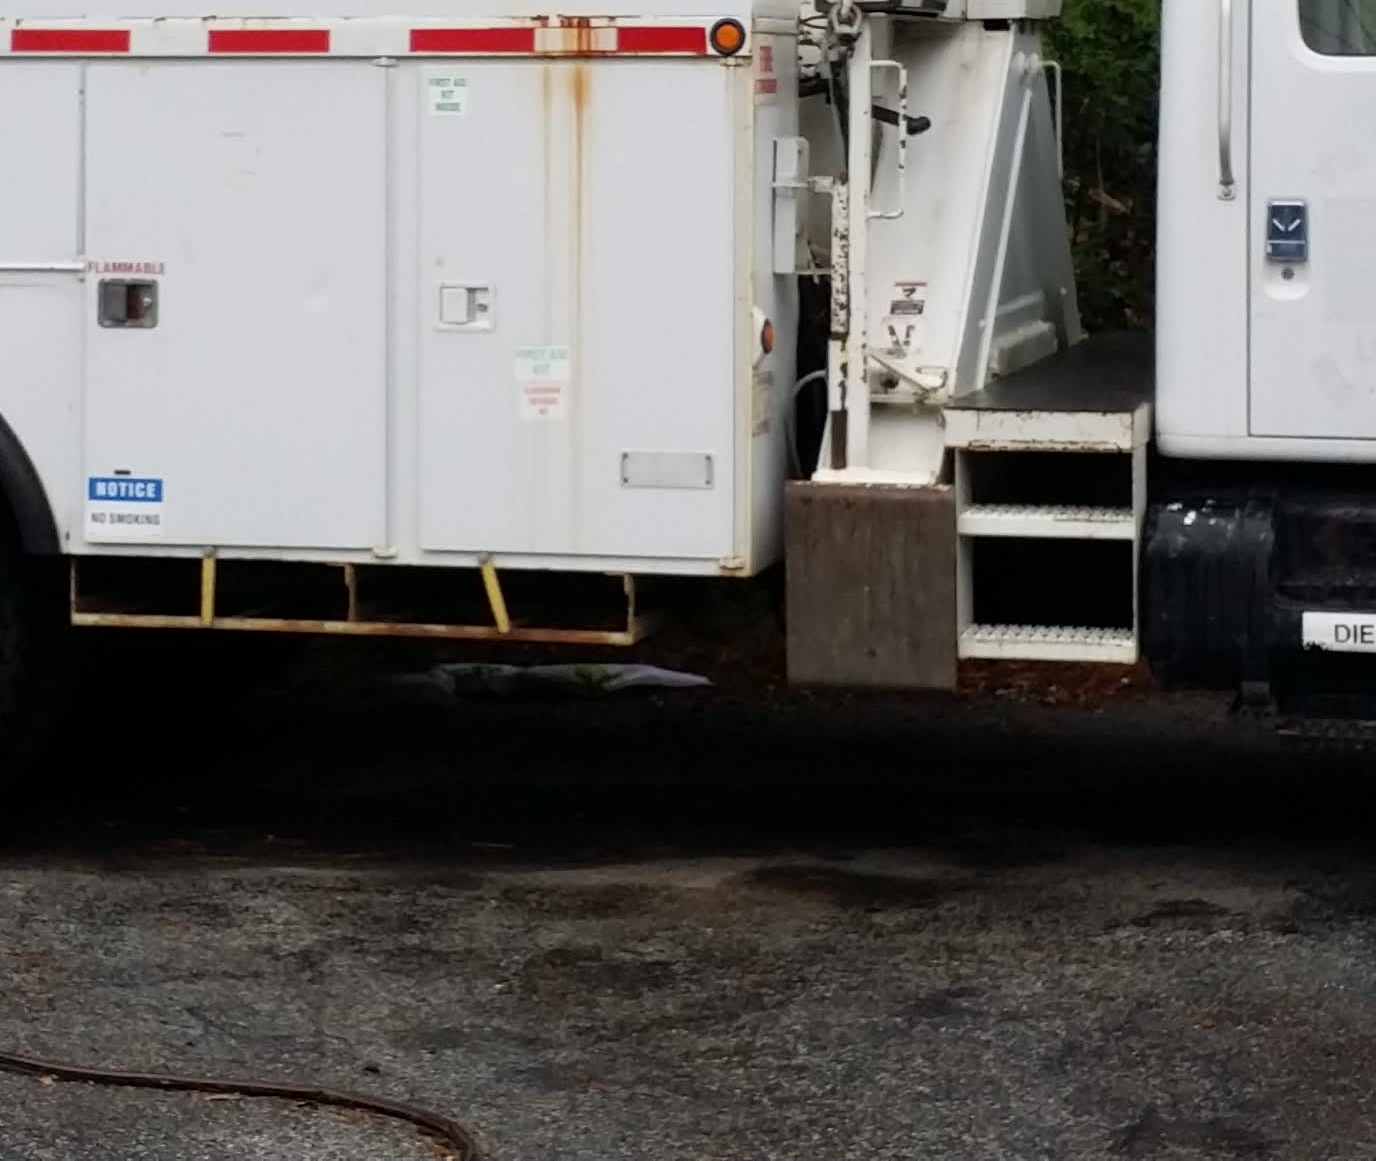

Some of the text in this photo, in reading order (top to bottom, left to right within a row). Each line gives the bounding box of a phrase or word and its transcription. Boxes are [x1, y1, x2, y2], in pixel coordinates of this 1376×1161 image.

[88, 261, 166, 275] FLAMMABLE
[96, 481, 156, 498] NOTICE
[91, 512, 161, 526] NO SMOKING
